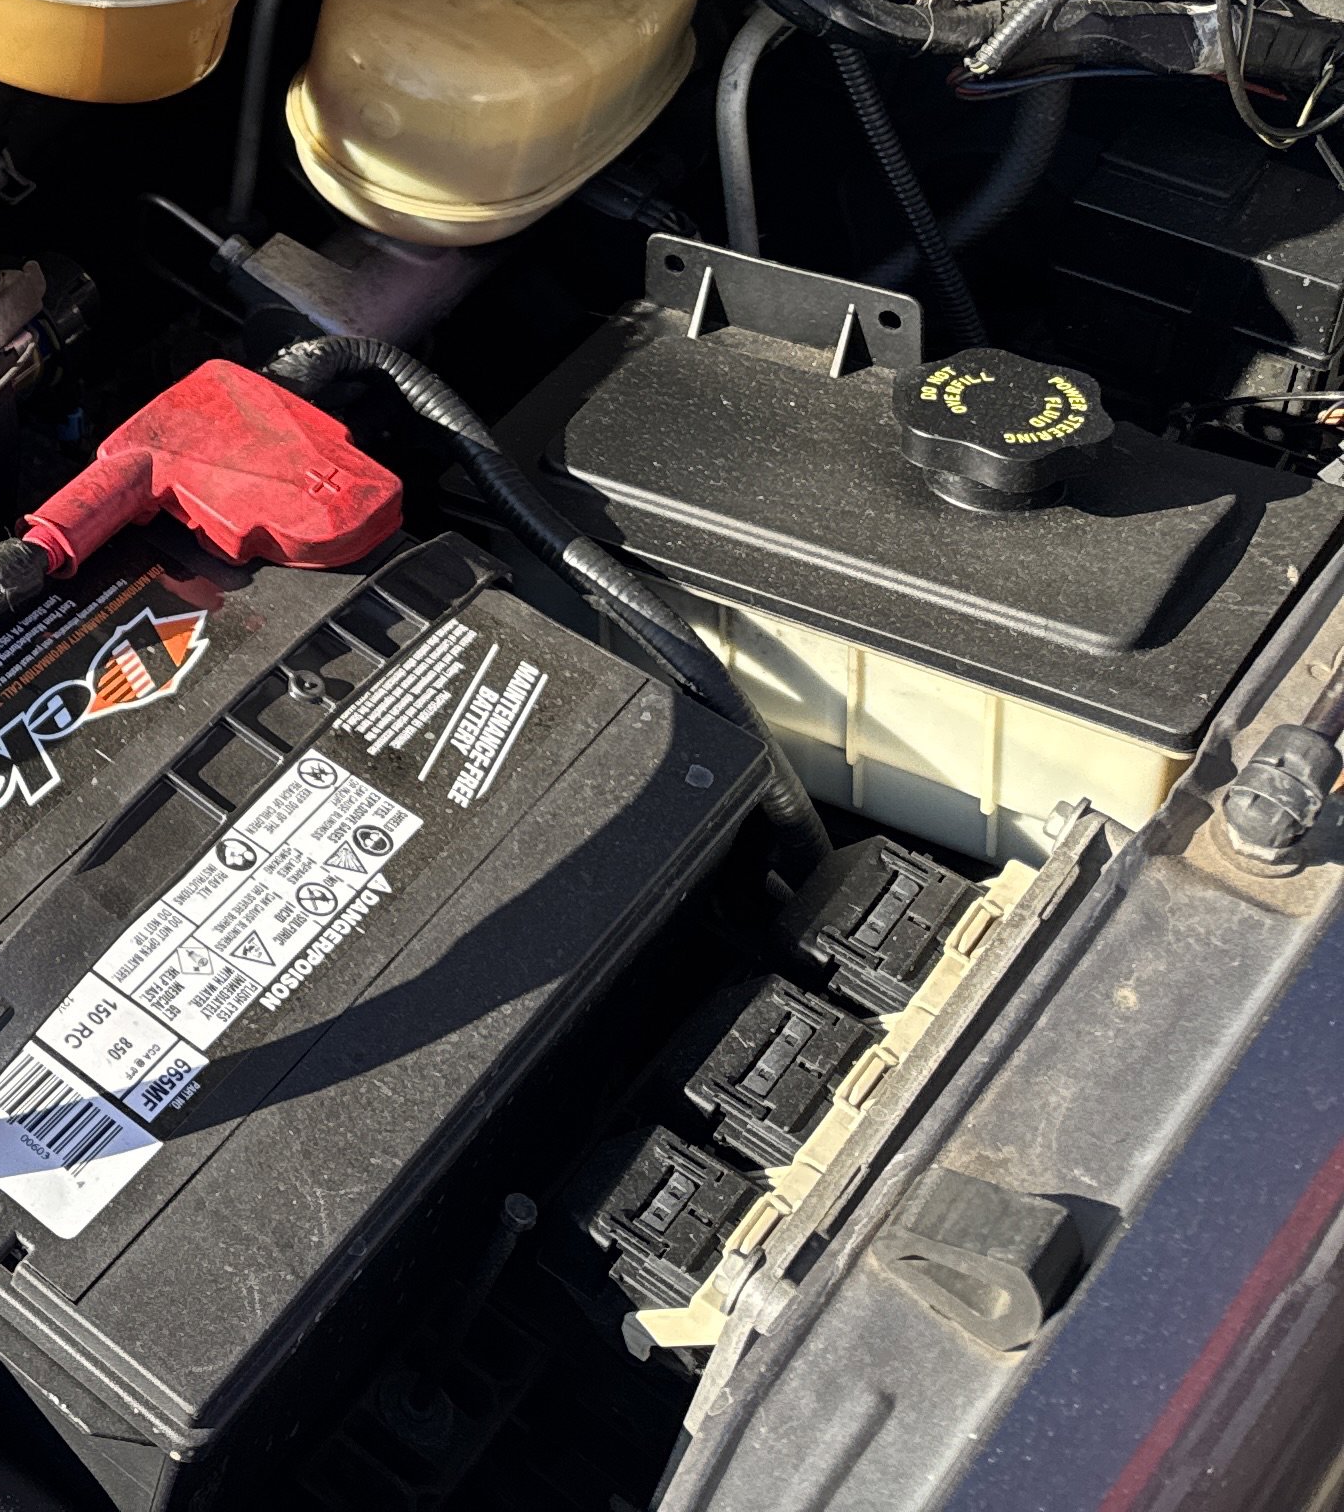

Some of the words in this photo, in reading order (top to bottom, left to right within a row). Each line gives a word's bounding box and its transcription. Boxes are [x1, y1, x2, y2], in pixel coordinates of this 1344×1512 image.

[920, 385, 938, 401] DO
[932, 366, 957, 386] NOT
[943, 372, 995, 414] OVERFILL
[1048, 376, 1088, 412] POWER
[1029, 396, 1062, 428] FLUID
[1003, 414, 1085, 444] STEERING
[146, 562, 164, 580] FOR
[41, 592, 62, 611] Lyon
[103, 573, 150, 615] NATIONWIDE
[41, 608, 63, 627] Penn
[57, 598, 76, 615] East
[9, 623, 24, 637] PA
[66, 608, 108, 645] WARRANTY
[18, 639, 70, 685] INFORMATION
[449, 684, 501, 756] BATTERY
[445, 660, 540, 809] MAINTENANCE-FREE
[278, 779, 302, 802] REACH
[346, 777, 359, 788] OR
[352, 783, 368, 798] CAN
[270, 797, 285, 809] OF
[292, 786, 312, 804] KEEP
[336, 794, 358, 813] CAUSE
[273, 811, 288, 823] OF
[280, 799, 299, 816] OUT
[344, 791, 381, 825] EXPLOSIVE
[371, 800, 395, 821] EYES.
[243, 804, 277, 835] CHILDREN
[261, 818, 280, 834] THE
[309, 809, 343, 841] BLINDNESS
[381, 809, 408, 833] SHIELD
[326, 821, 352, 844] GASES
[206, 869, 228, 889] READ
[249, 884, 264, 896] OR
[322, 874, 338, 887] NO
[195, 884, 213, 899] ALL
[258, 891, 276, 906] CAN
[155, 907, 172, 921] DO
[230, 892, 256, 915] SEVERE
[241, 902, 265, 923] CAUSE
[272, 903, 295, 923] ACID
[142, 916, 162, 934] NOT
[153, 924, 173, 941] NOT
[165, 914, 183, 929] DO
[271, 912, 307, 946] SULFURIC
[137, 936, 161, 957] OPEN
[213, 919, 248, 952] BLINDNESS
[256, 886, 381, 1012] DANGER/POISON
[109, 951, 145, 984] BATTERY.
[155, 965, 180, 987] HELP
[209, 964, 234, 986] WITH
[138, 981, 164, 1004] FAST.
[149, 979, 185, 1013] MEDICAL
[186, 981, 218, 1010] WATER.
[198, 972, 247, 1020] IMMEDIATELY
[231, 981, 258, 1005] FLUSH
[86, 998, 118, 1025] 150
[160, 1003, 181, 1021] GET
[215, 1001, 238, 1022] EYES
[64, 1022, 94, 1050] RC
[107, 1037, 134, 1060] 850
[143, 1043, 161, 1061] CCA
[134, 1058, 146, 1068] @
[141, 1058, 192, 1113] 665MF
[182, 1080, 201, 1101] PART
[20, 1134, 50, 1160] 00603
[76, 1180, 86, 1189] 4
